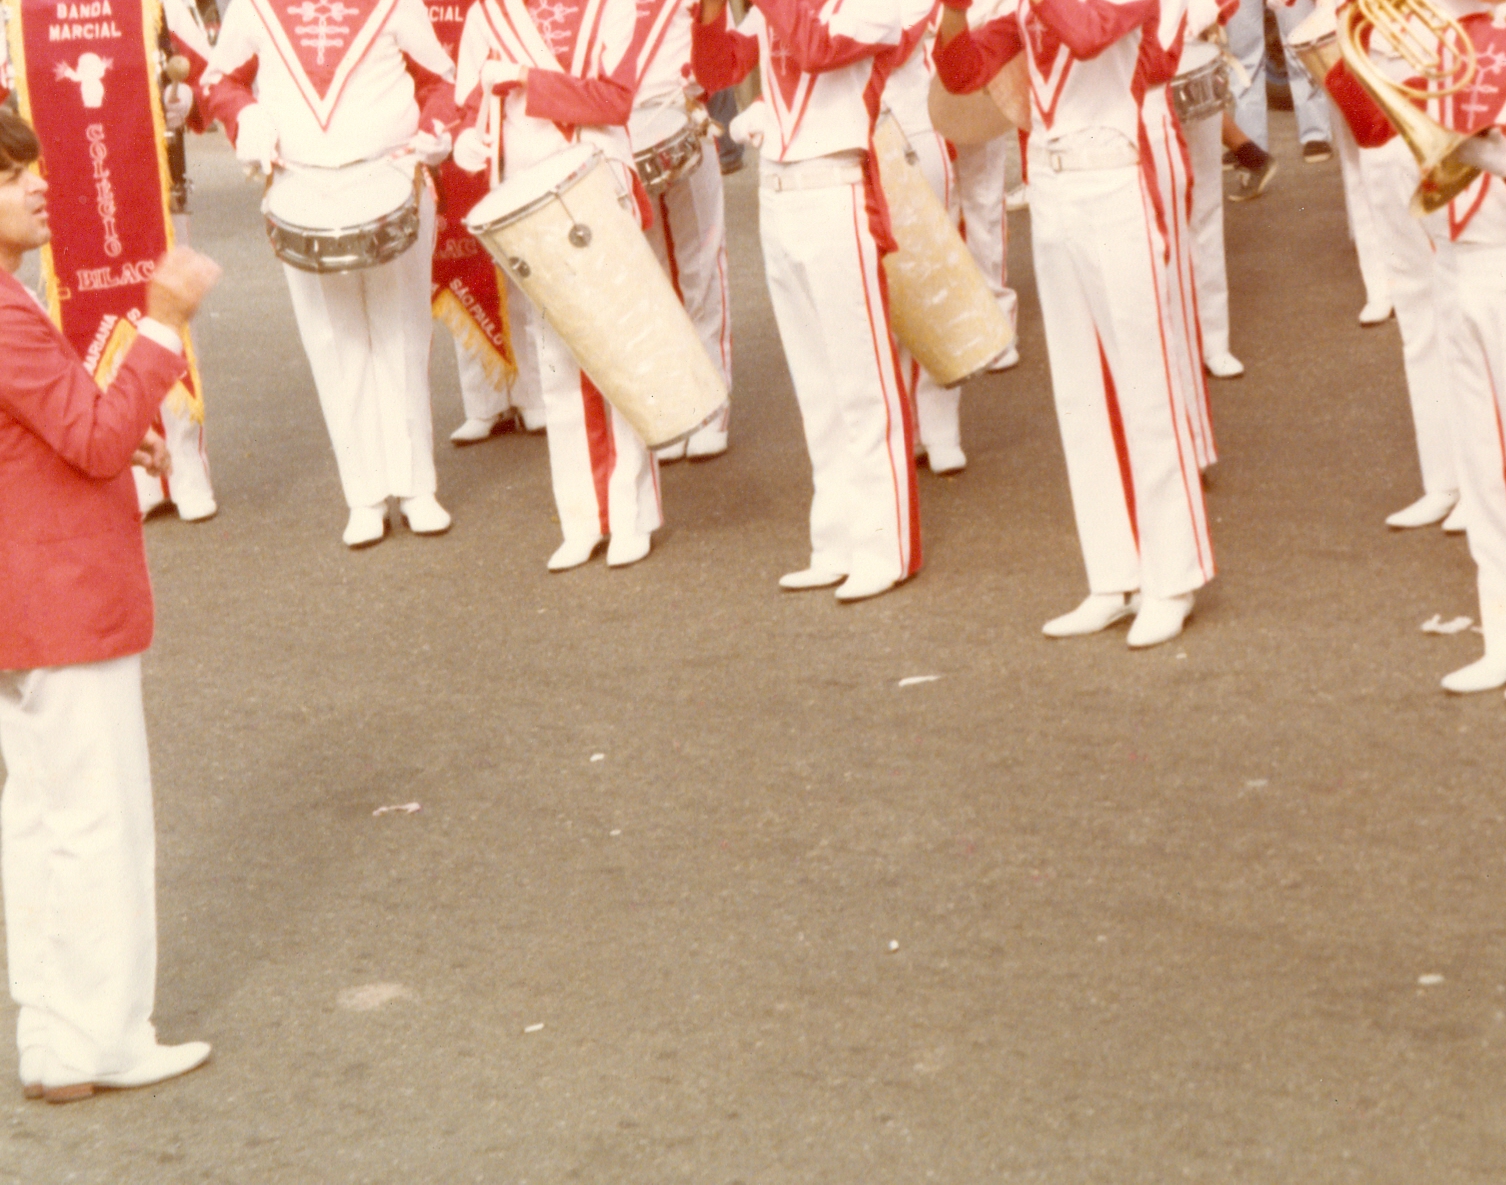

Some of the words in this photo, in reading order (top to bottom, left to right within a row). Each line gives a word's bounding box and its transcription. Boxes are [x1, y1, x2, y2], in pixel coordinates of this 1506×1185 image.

[428, 4, 464, 23] CIAL
[49, 20, 122, 43] MARCIAL
[76, 260, 155, 292] BILAC
[469, 302, 503, 346] PAULO
